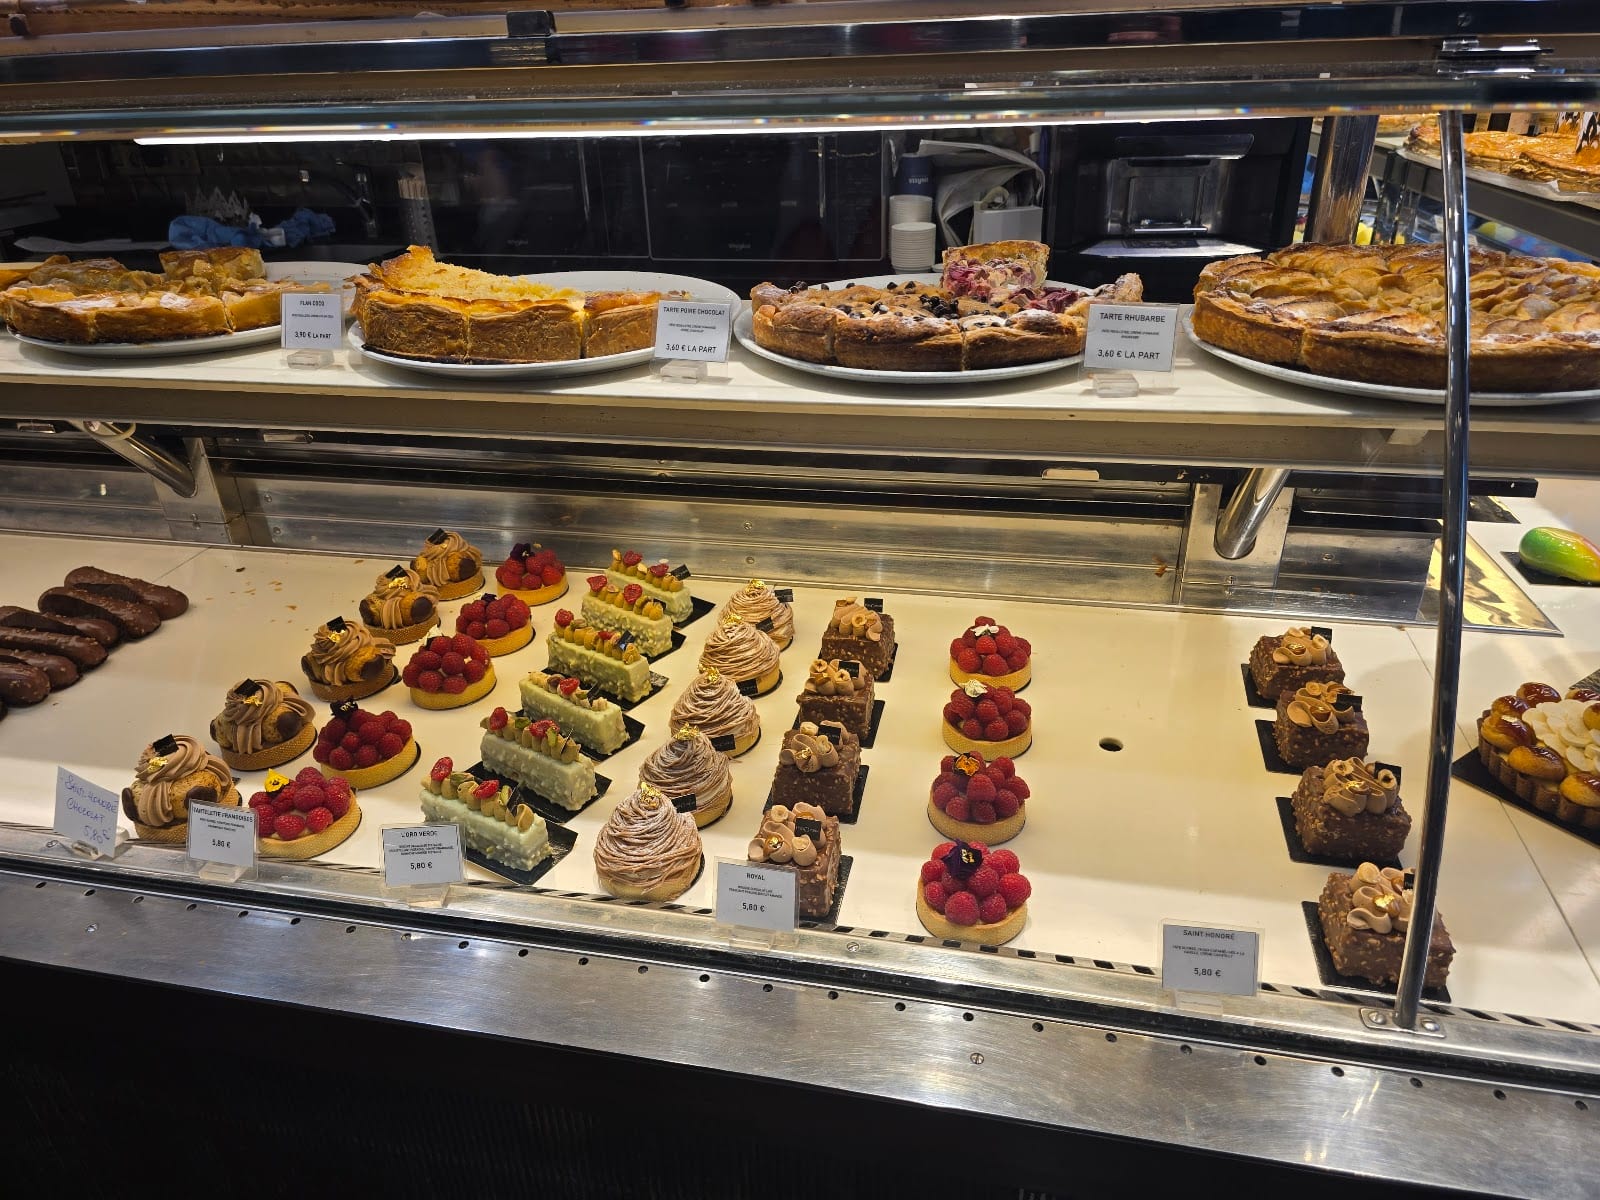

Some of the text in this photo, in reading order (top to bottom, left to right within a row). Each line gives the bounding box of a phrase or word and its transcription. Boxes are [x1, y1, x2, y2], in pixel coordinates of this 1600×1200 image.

[1100, 312, 1166, 323] TARTE RHUBARBE
[666, 343, 717, 354] 3,60 € LA PART
[1097, 349, 1160, 360] 3,60 € LA PART
[193, 806, 253, 823] TARTELETTE FRAMBOISES
[212, 838, 225, 848] 5,80
[410, 861, 433, 870] 5,80 €
[746, 872, 766, 881] ROYAL
[742, 902, 766, 913] 5,80 €
[1183, 929, 1235, 941] SAINT HONORÉ
[1193, 967, 1222, 977] 5,80 €
